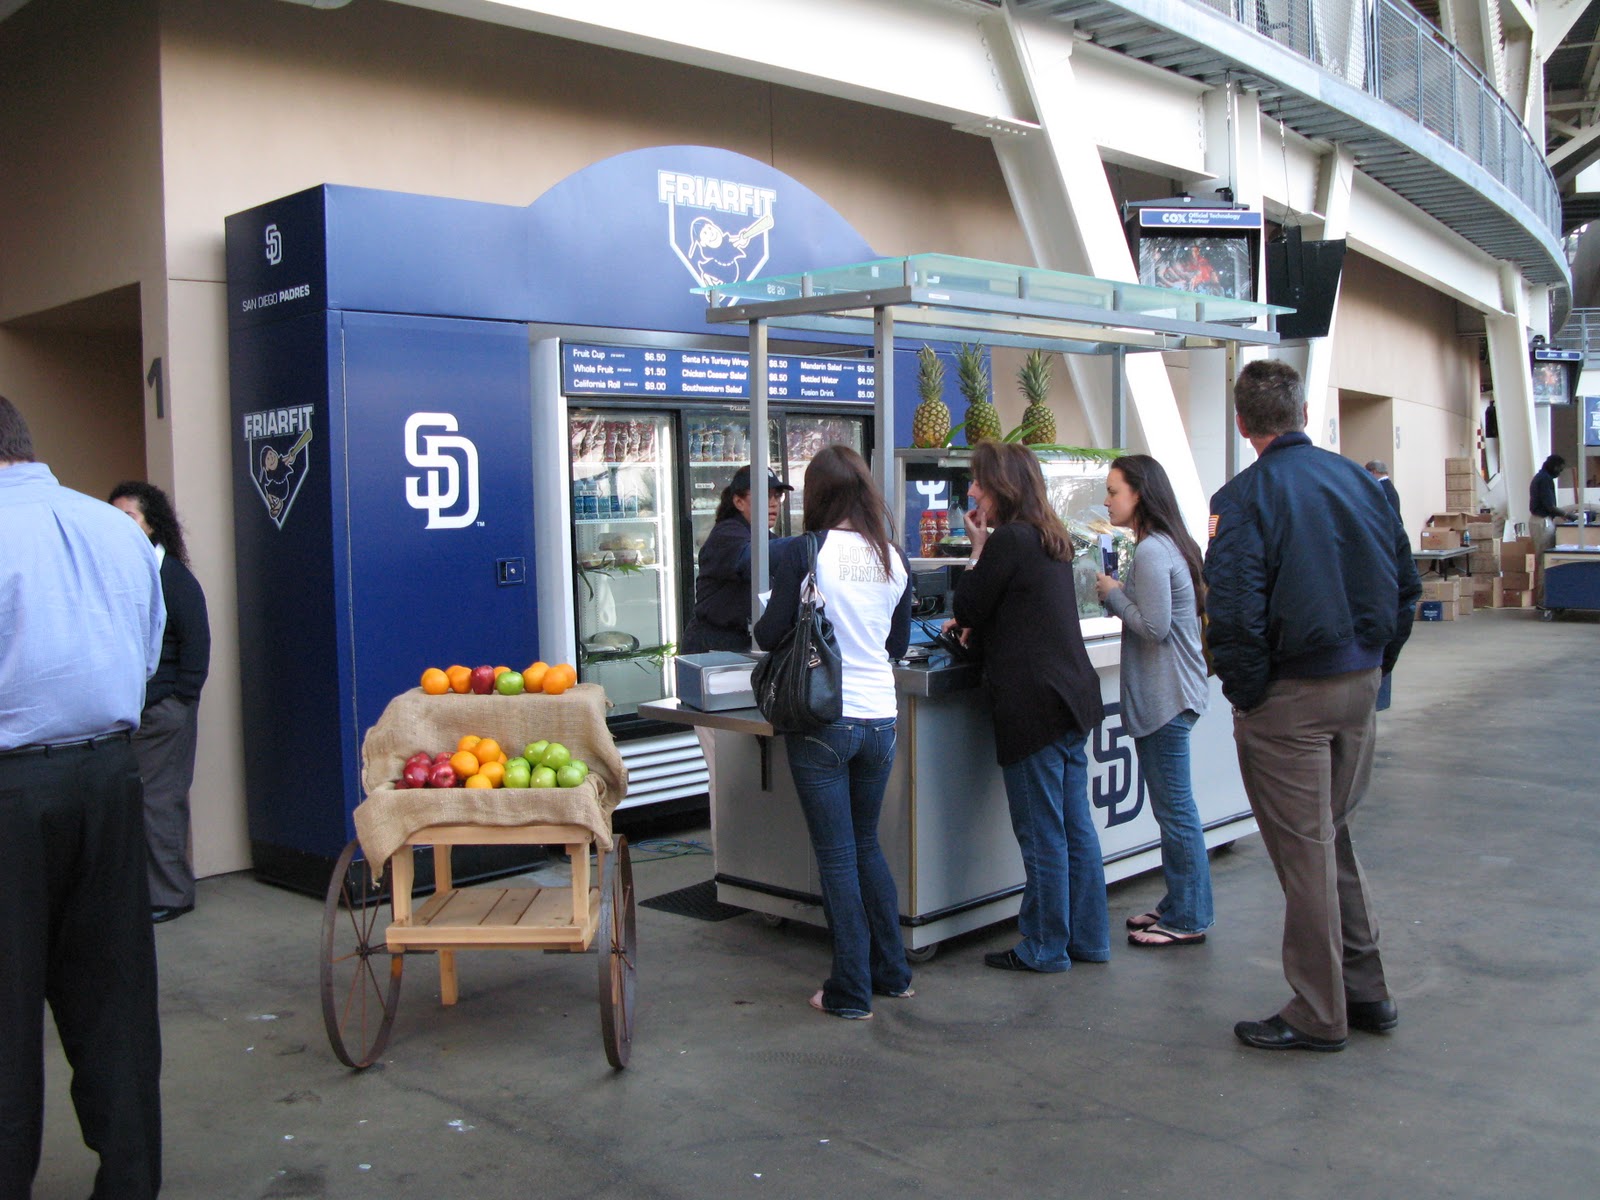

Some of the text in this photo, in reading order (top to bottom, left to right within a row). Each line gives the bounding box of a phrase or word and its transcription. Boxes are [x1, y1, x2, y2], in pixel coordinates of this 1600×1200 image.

[657, 170, 777, 217] FRIARFIT
[1162, 212, 1187, 224] COX
[242, 284, 311, 312] SAN DIEGO PADRES
[573, 349, 590, 358] Fruit
[591, 350, 606, 361] Cup
[682, 354, 700, 364] Santa
[701, 355, 710, 364] Fe
[711, 356, 731, 367] Turkey
[731, 357, 749, 368] Wrap
[800, 361, 826, 371] Mandarin
[827, 363, 843, 372] Salad
[573, 364, 596, 373] Whole
[597, 365, 614, 375] Fruit
[644, 366, 666, 377] $1.50
[682, 368, 706, 378] Chicken
[729, 371, 747, 381] Salad
[800, 375, 820, 385] Bottled
[821, 376, 839, 385] Water
[857, 377, 875, 387] $4.00
[147, 356, 165, 419] 1
[573, 379, 606, 389] California
[607, 380, 621, 390] Roll
[682, 383, 724, 393] Southwestern
[725, 385, 743, 394] Salad
[801, 388, 819, 397] Fusion
[820, 389, 835, 398] Drink
[244, 404, 314, 440] FRIARFIT
[1395, 426, 1401, 449] 5
[838, 544, 885, 565] LOV
[838, 564, 887, 583] PINK
